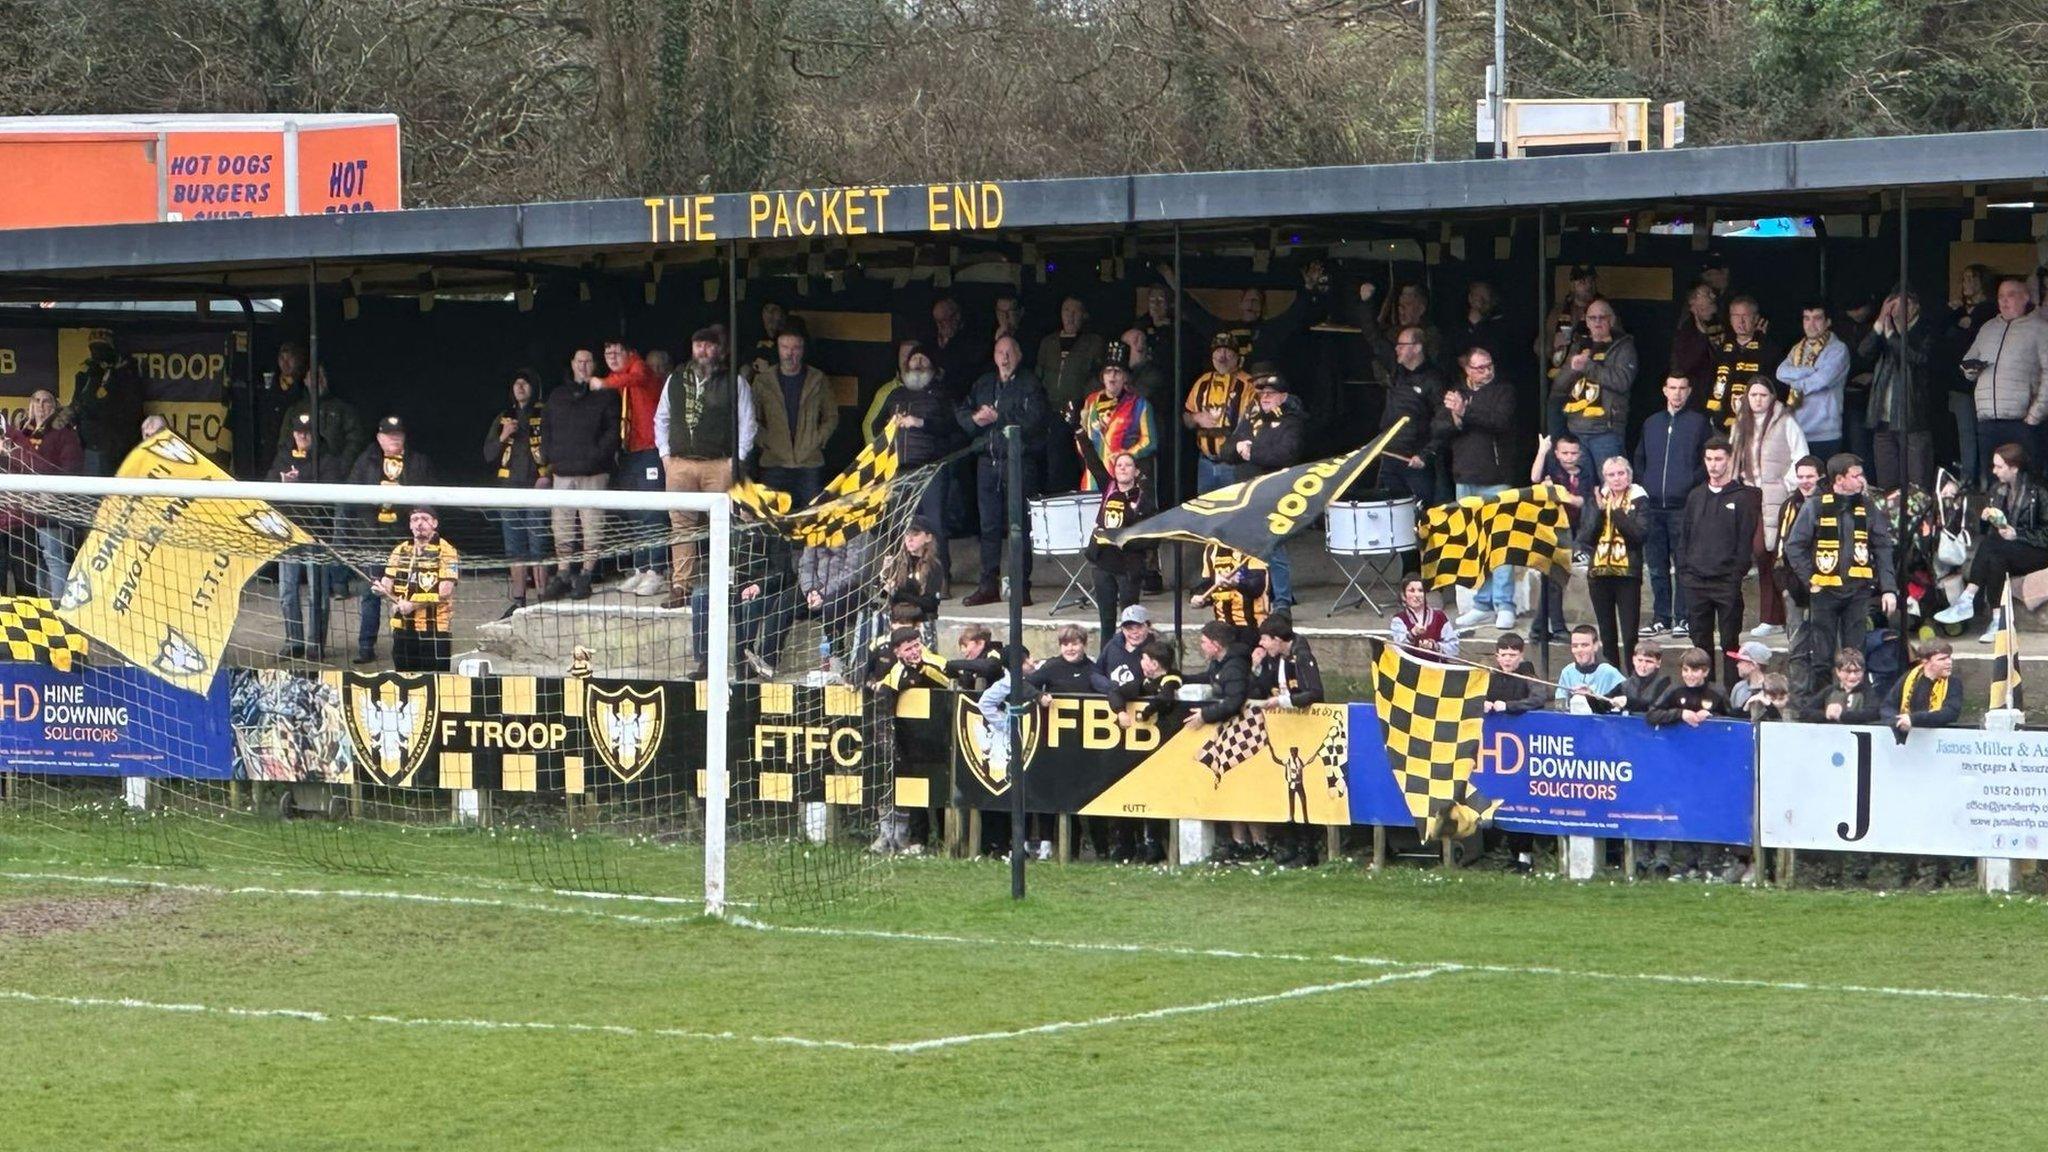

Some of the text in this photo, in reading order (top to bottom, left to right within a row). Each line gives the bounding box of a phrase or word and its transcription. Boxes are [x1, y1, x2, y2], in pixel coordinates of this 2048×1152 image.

[171, 155, 273, 175] HOT DOGS
[329, 160, 367, 198] HOT
[173, 183, 271, 204] BURGERS
[644, 182, 1004, 243] THE PACKET END
[131, 352, 225, 380] TROOP
[44, 684, 84, 703] HINE
[44, 705, 129, 726] DOWNING
[1047, 697, 1161, 751] FBB
[44, 726, 119, 743] SOLICITORS
[441, 720, 458, 746] F
[465, 720, 567, 750] TROOP
[1529, 734, 1574, 757] HINE
[754, 724, 864, 768] FTFC
[1936, 739, 1972, 755] James
[1975, 741, 2014, 757] Miller
[2017, 743, 2029, 757] &
[1528, 757, 1633, 783] DOWNING
[2009, 762, 2018, 772] &
[1528, 780, 1618, 801] SOLICITORS
